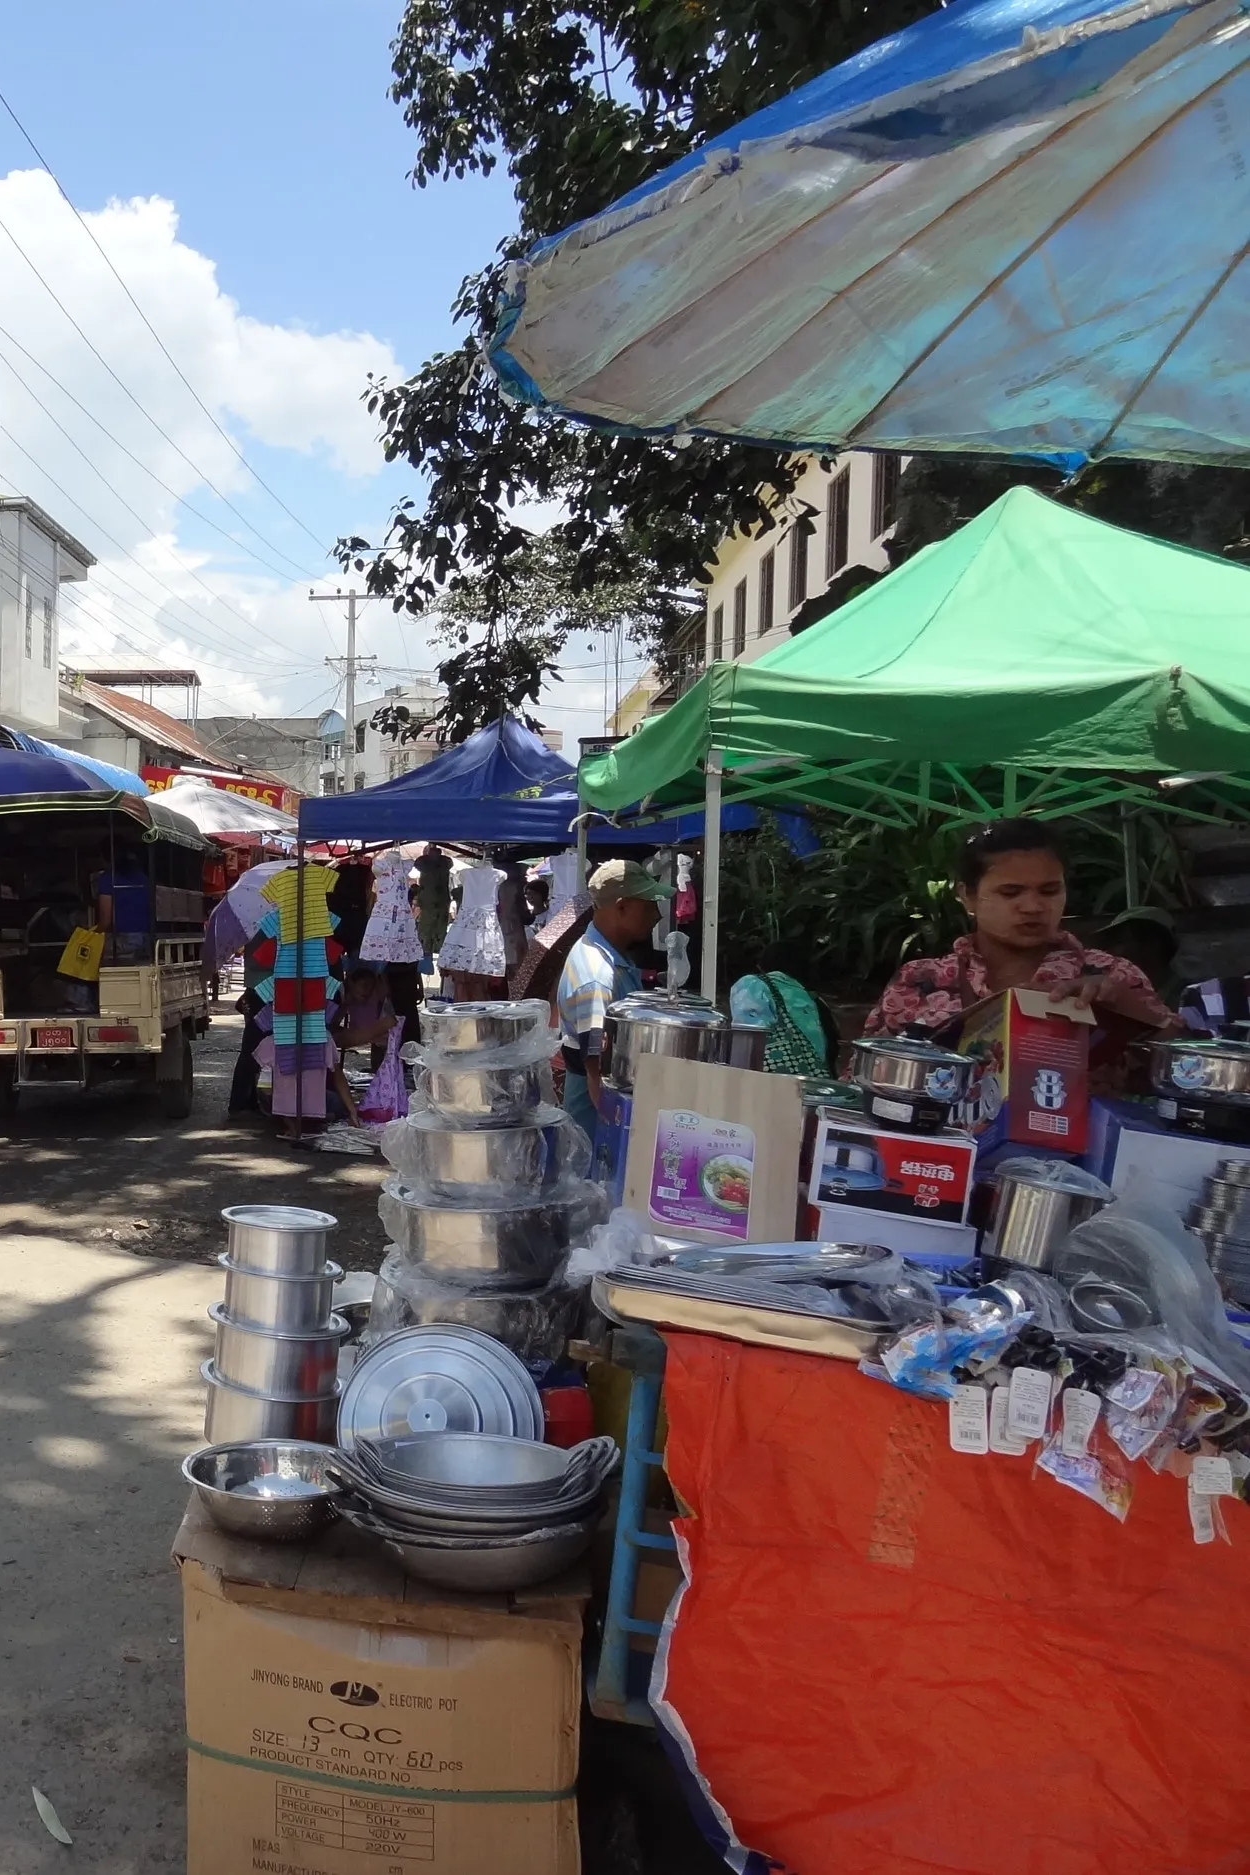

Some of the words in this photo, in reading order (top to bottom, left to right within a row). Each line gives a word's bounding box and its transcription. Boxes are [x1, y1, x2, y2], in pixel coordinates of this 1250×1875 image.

[251, 1668, 290, 1687] JINYONG
[292, 1675, 324, 1694] BRAND
[389, 1693, 433, 1710] ELECTRIC
[439, 1698, 458, 1712] POT
[308, 1716, 402, 1745] CQC
[250, 1746, 313, 1767] PRODUCT
[315, 1759, 387, 1781] STANDARD
[390, 1772, 411, 1783] NO
[331, 1747, 350, 1759] cm
[406, 1751, 434, 1769] 60
[439, 1760, 463, 1772] pcs
[281, 1785, 311, 1799] STYLE
[281, 1799, 340, 1817] FREQUENCY
[349, 1799, 386, 1812] MODEL
[281, 1813, 317, 1827] POWER
[366, 1814, 400, 1828] 50Hz
[281, 1826, 325, 1844] VOLTAGE
[365, 1842, 400, 1855] 220V
